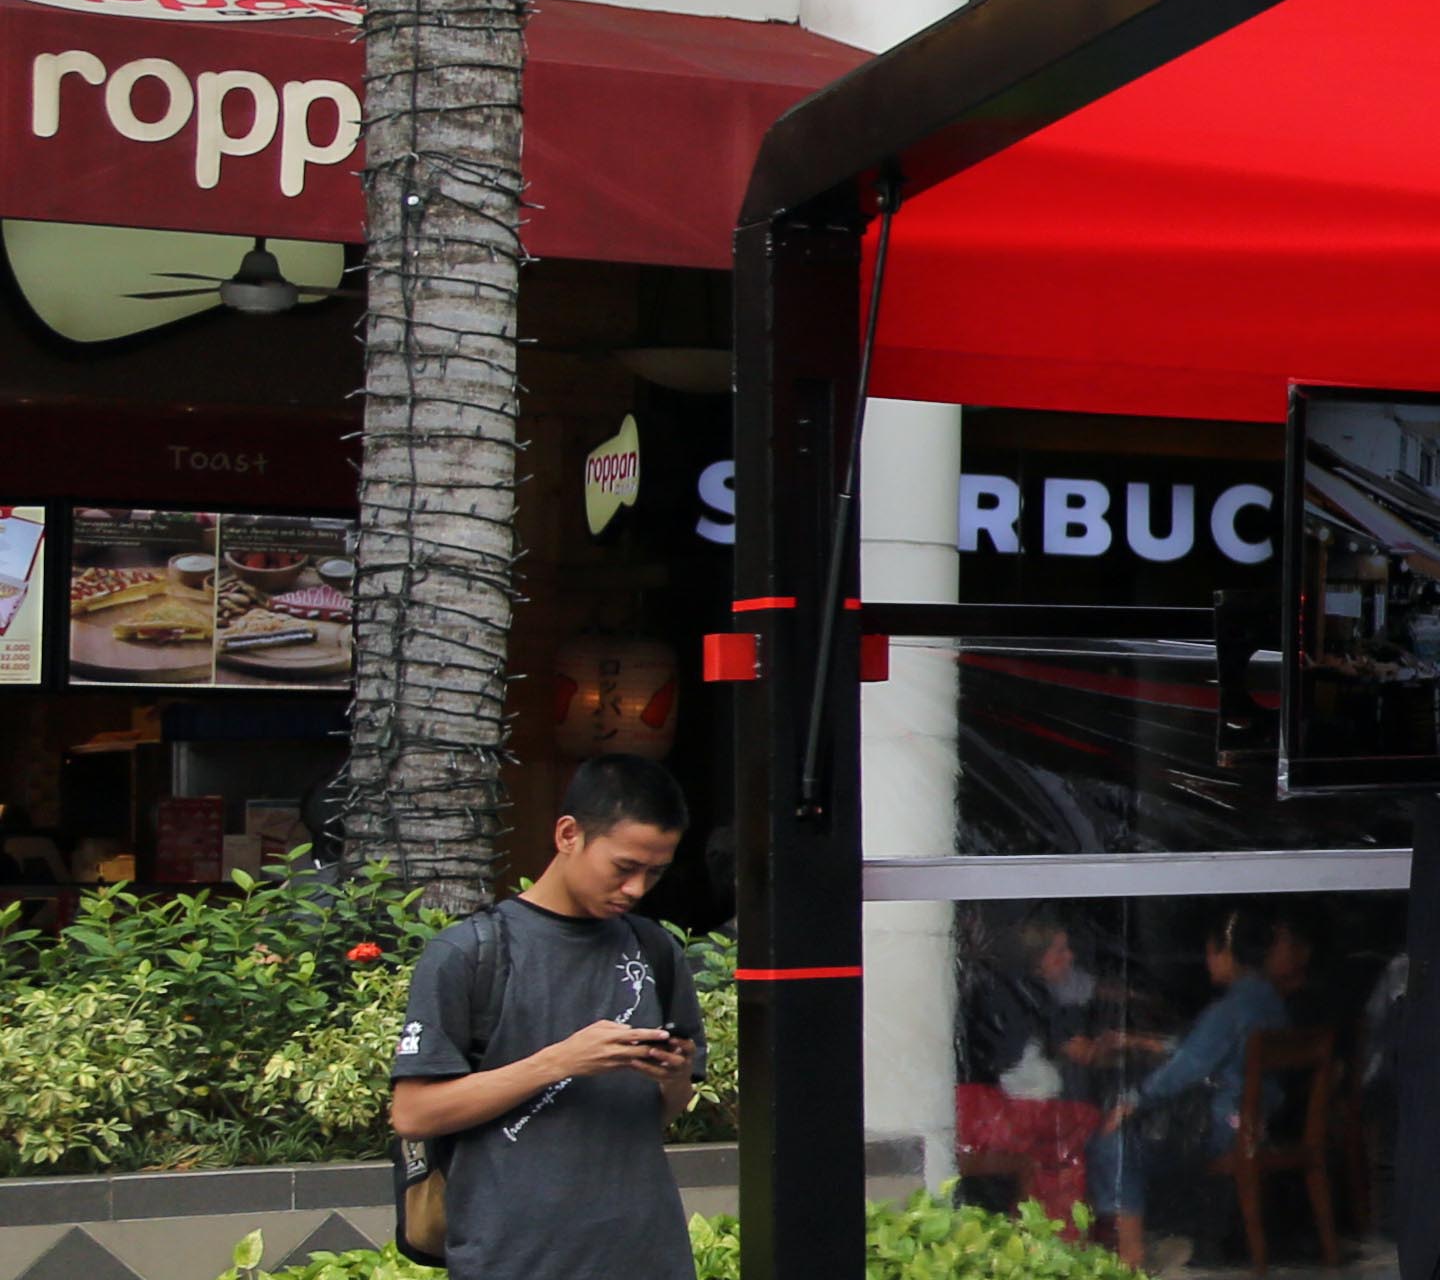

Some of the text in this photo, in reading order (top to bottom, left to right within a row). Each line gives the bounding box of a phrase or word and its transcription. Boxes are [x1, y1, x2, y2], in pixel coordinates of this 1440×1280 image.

[32, 49, 364, 199] ropp
[166, 443, 271, 476] Toast
[587, 451, 637, 493] roppan
